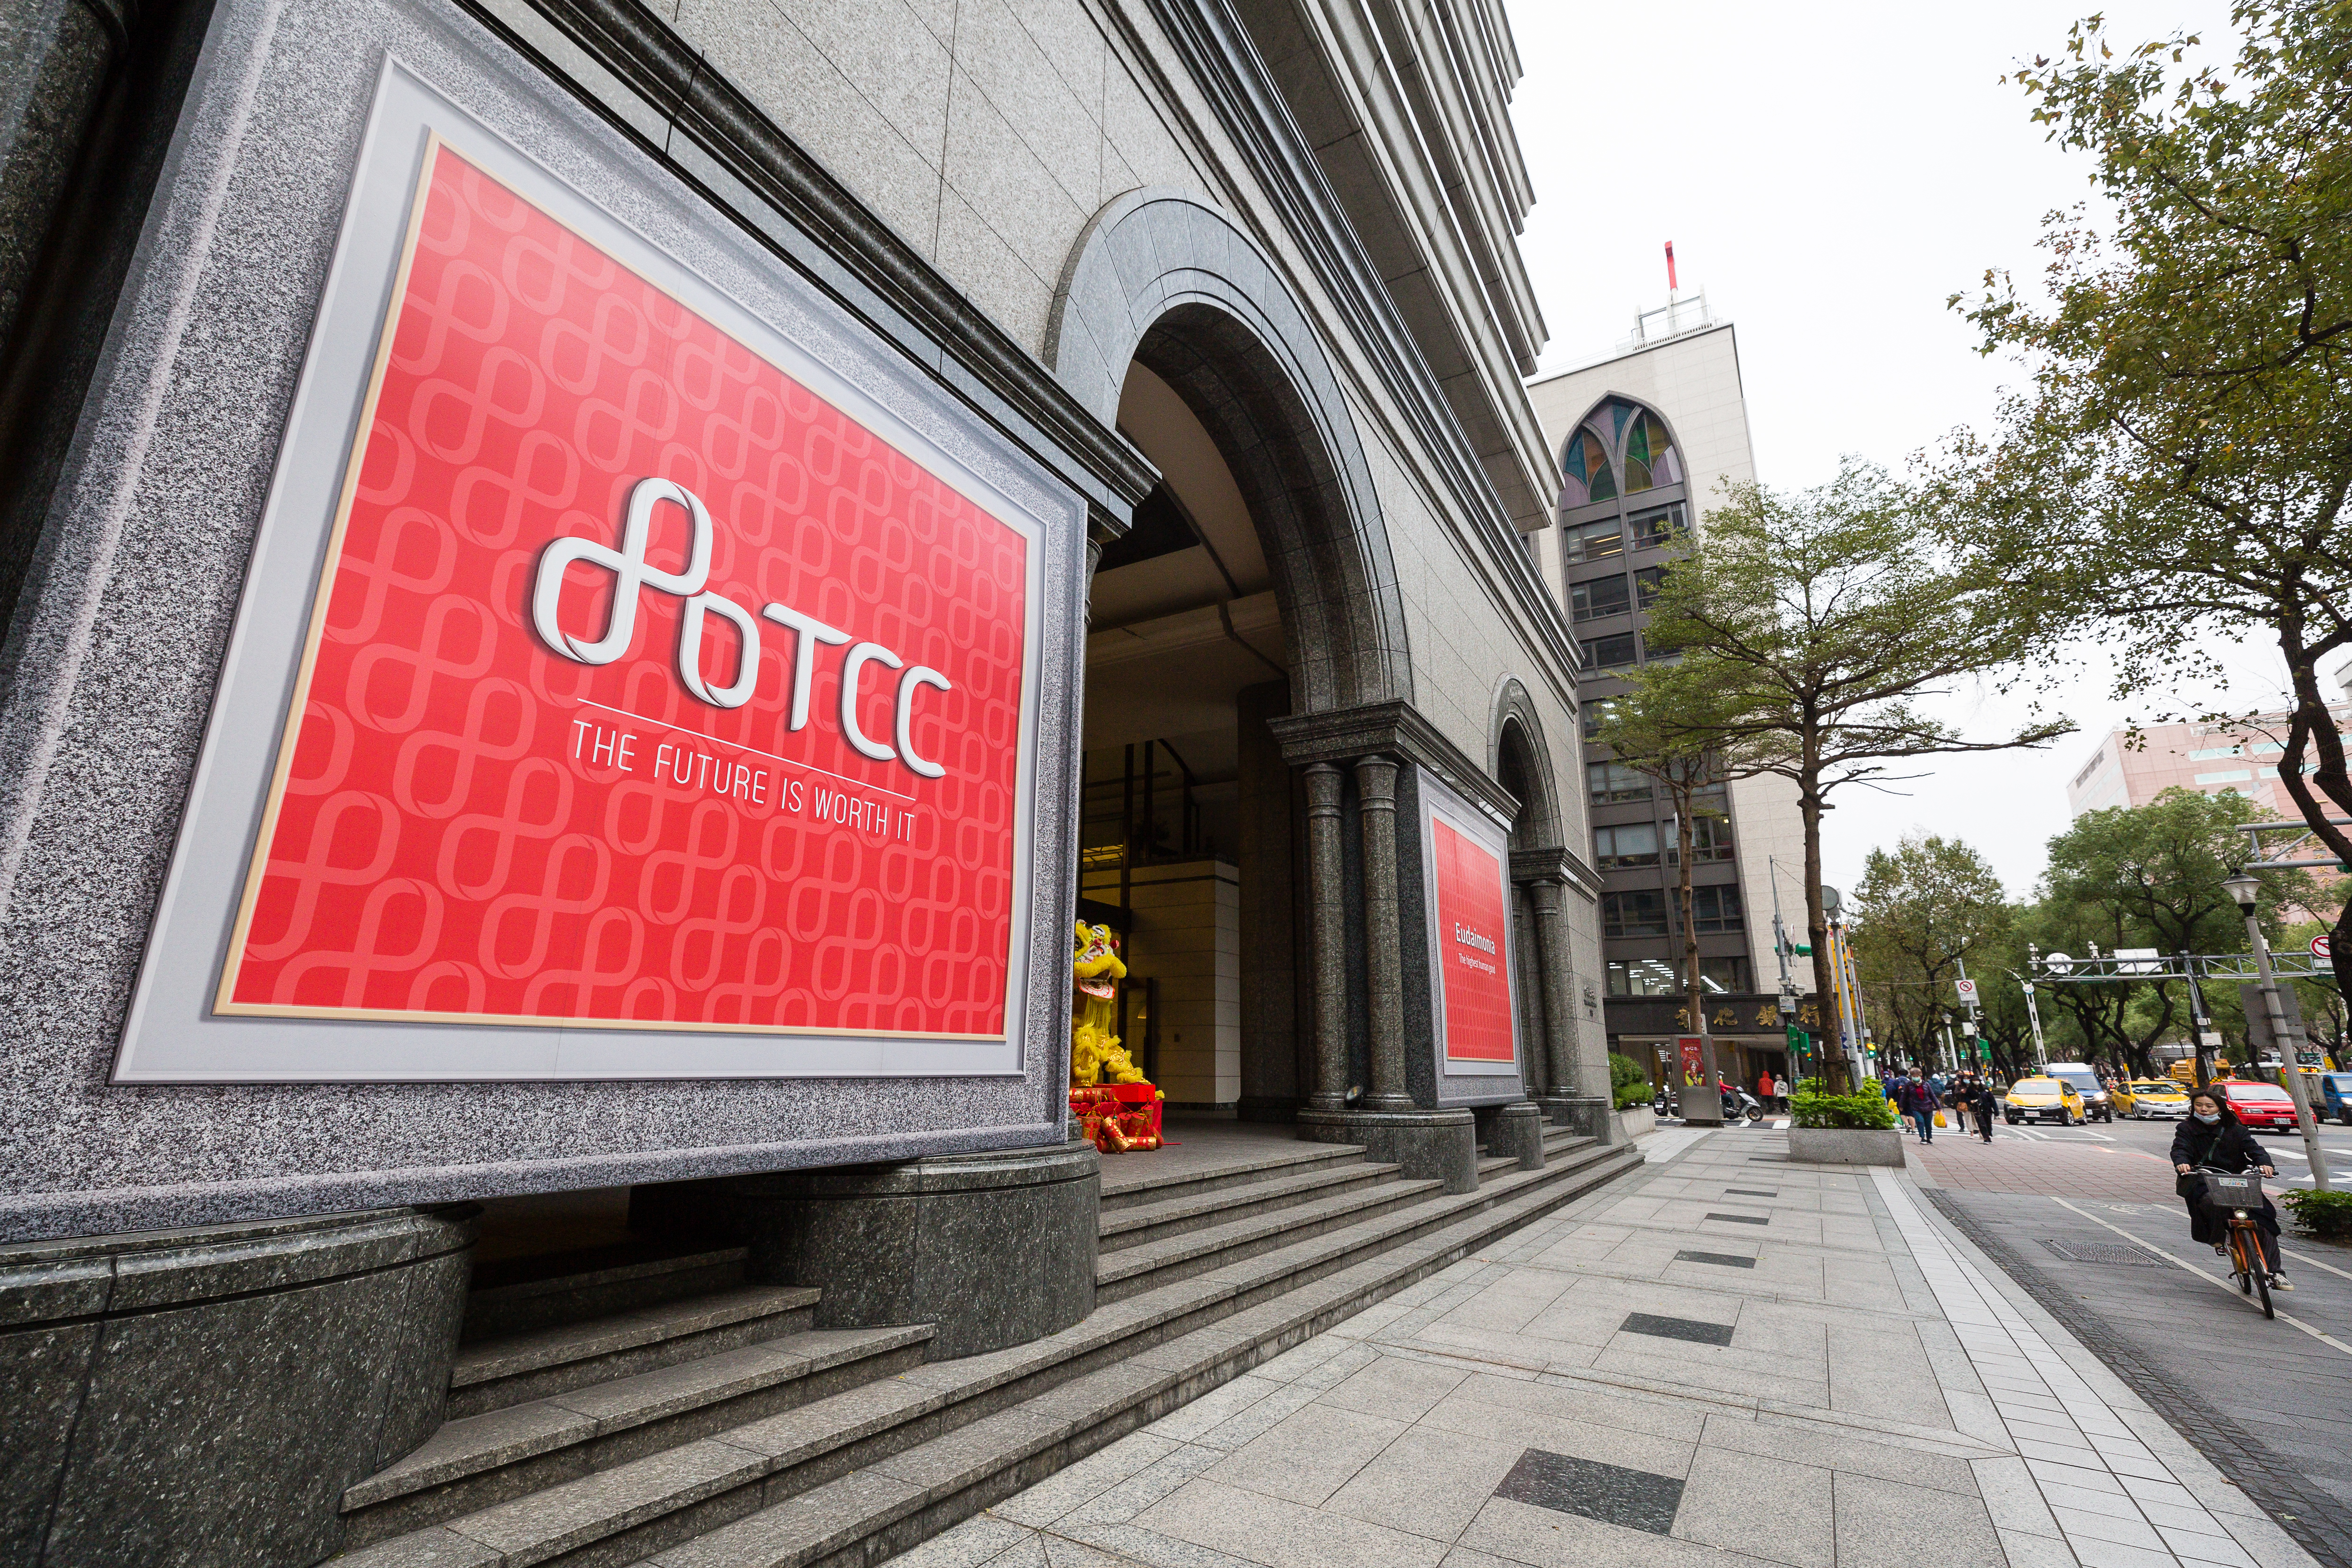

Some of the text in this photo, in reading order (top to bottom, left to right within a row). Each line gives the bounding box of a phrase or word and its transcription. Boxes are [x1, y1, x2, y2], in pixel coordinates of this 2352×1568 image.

[572, 720, 915, 842] THE FUTURE IS WORTH IT
[1455, 922, 1496, 955] Eudaimonia
[1466, 954, 1479, 969] highest
[1478, 958, 1489, 971] human
